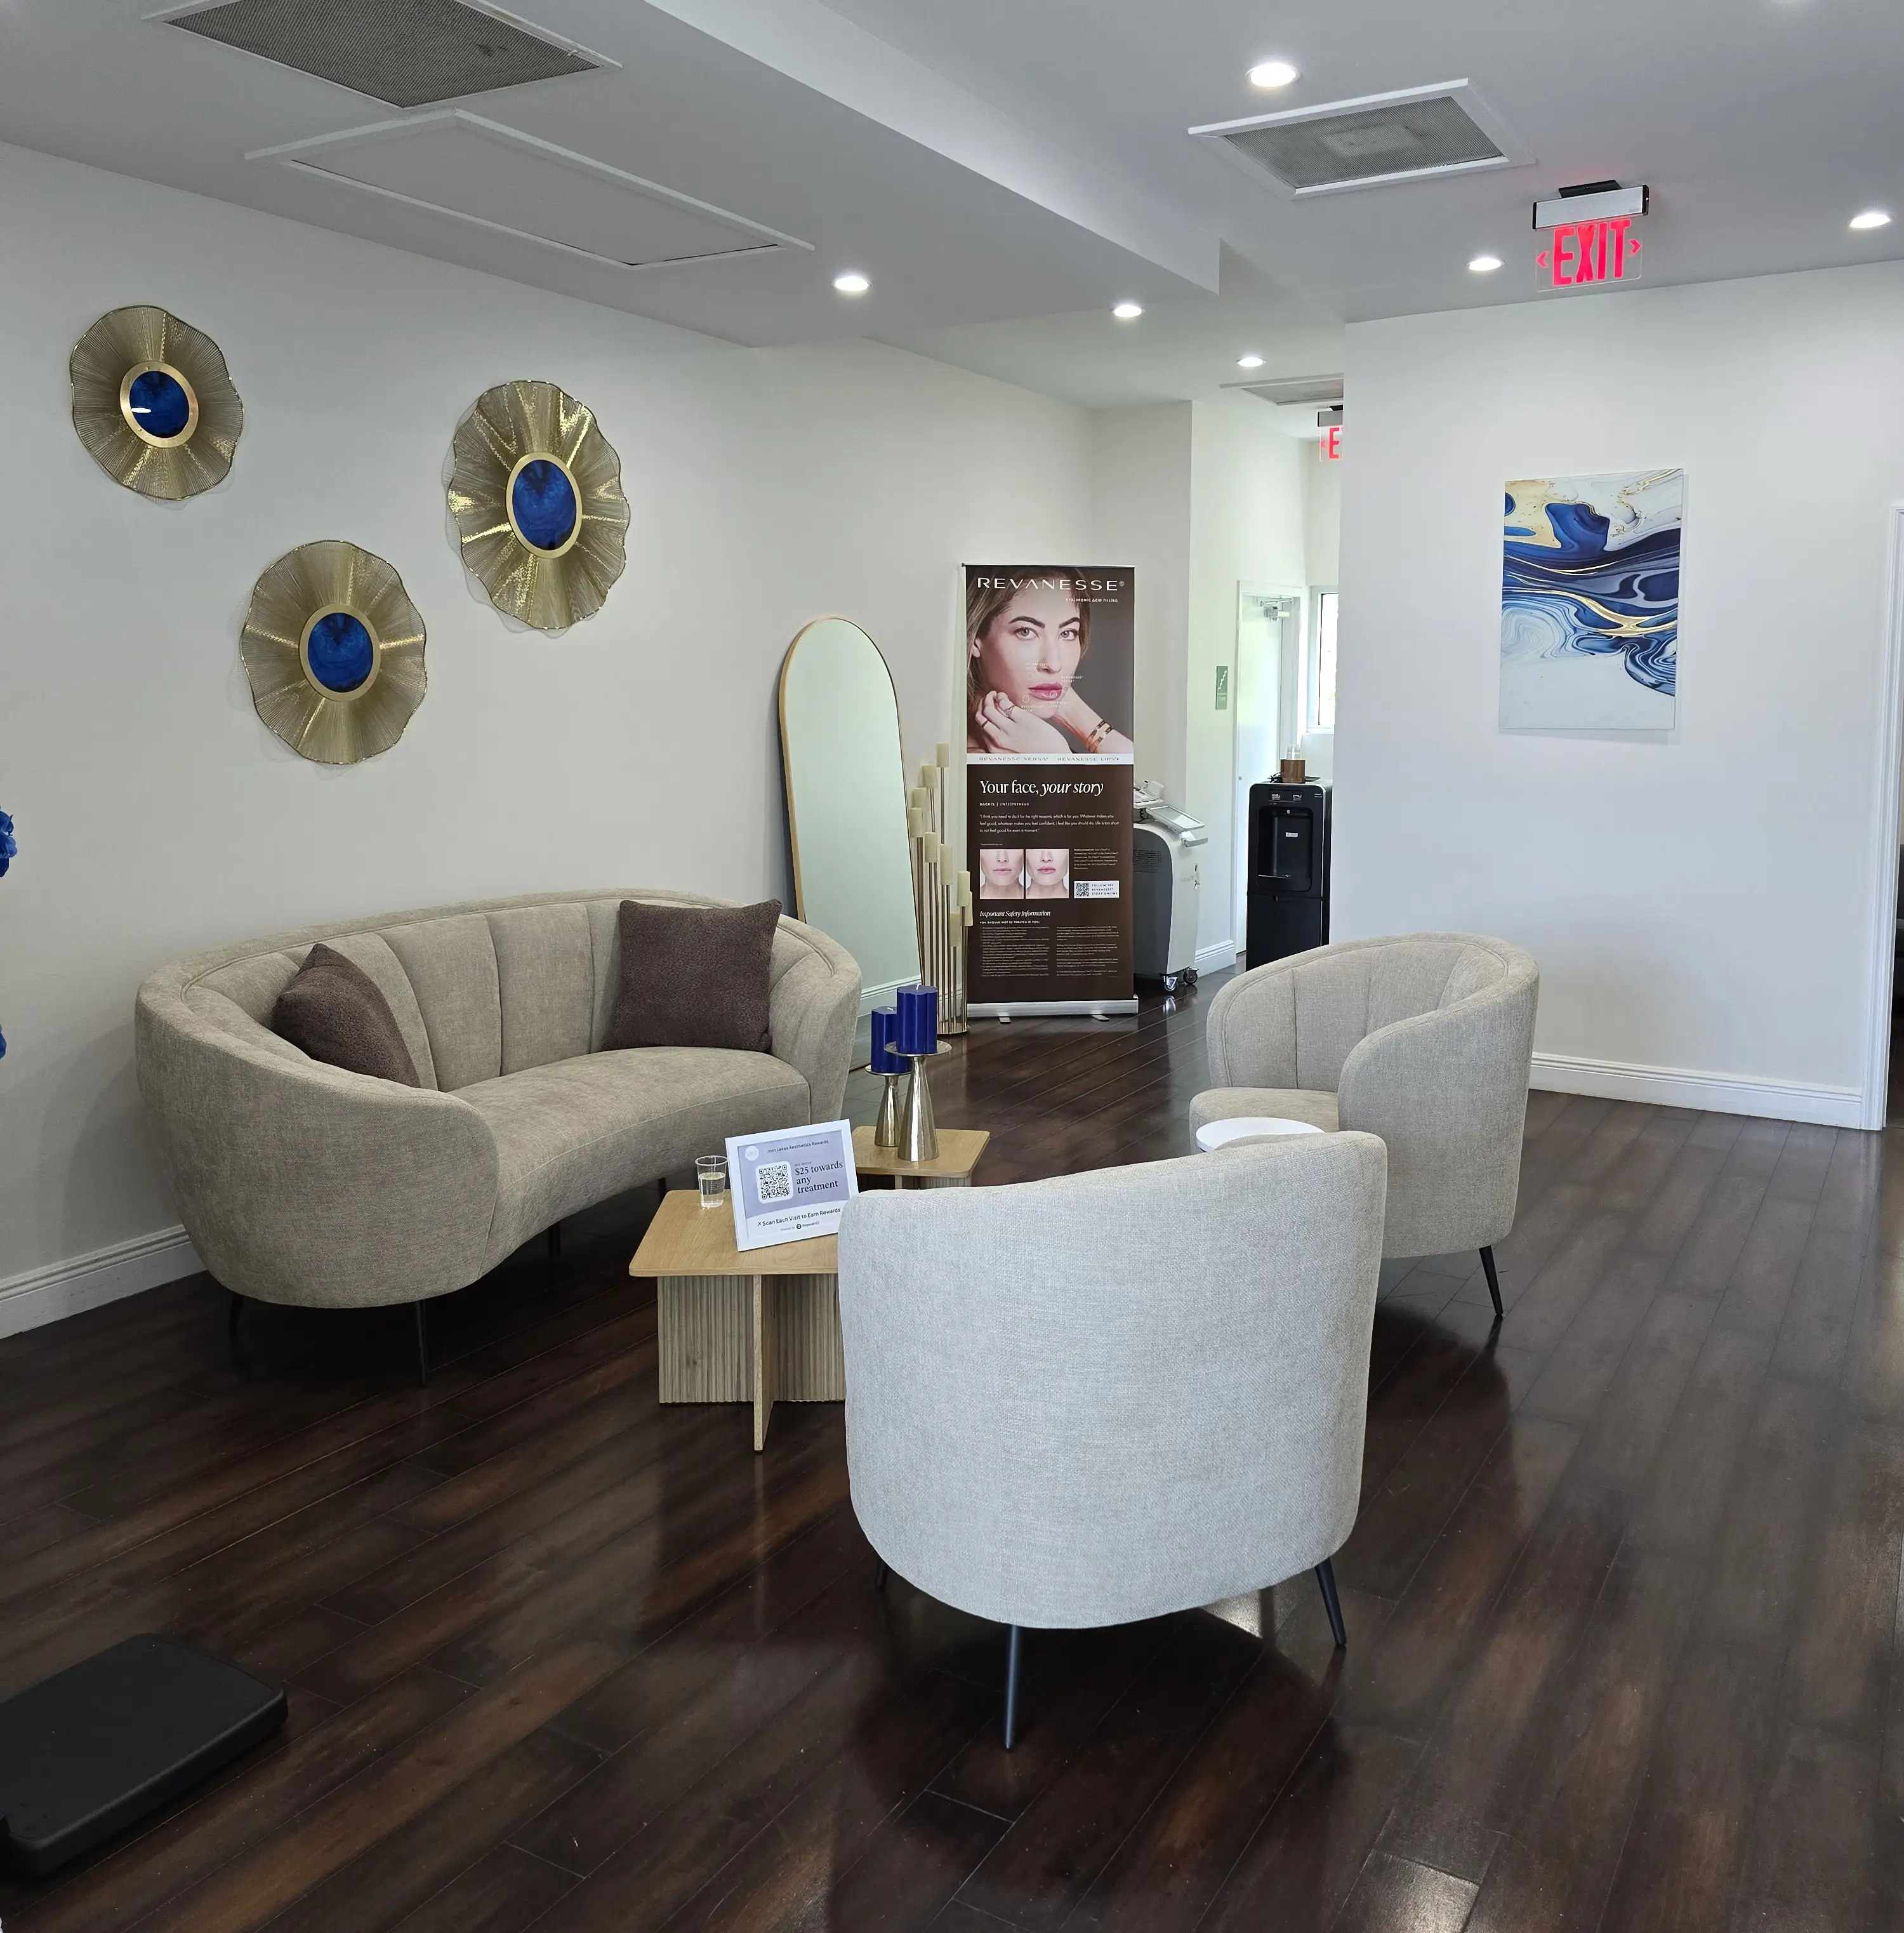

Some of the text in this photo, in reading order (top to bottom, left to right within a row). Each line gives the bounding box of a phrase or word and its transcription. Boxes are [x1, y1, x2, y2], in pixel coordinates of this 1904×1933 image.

[1552, 218, 1631, 286] EXIT
[979, 780, 1104, 797] Your face, your story
[795, 1160, 843, 1176] $25 towards
[796, 1176, 812, 1185] any
[797, 1180, 838, 1194] treatment
[819, 1207, 841, 1216] Rewards
